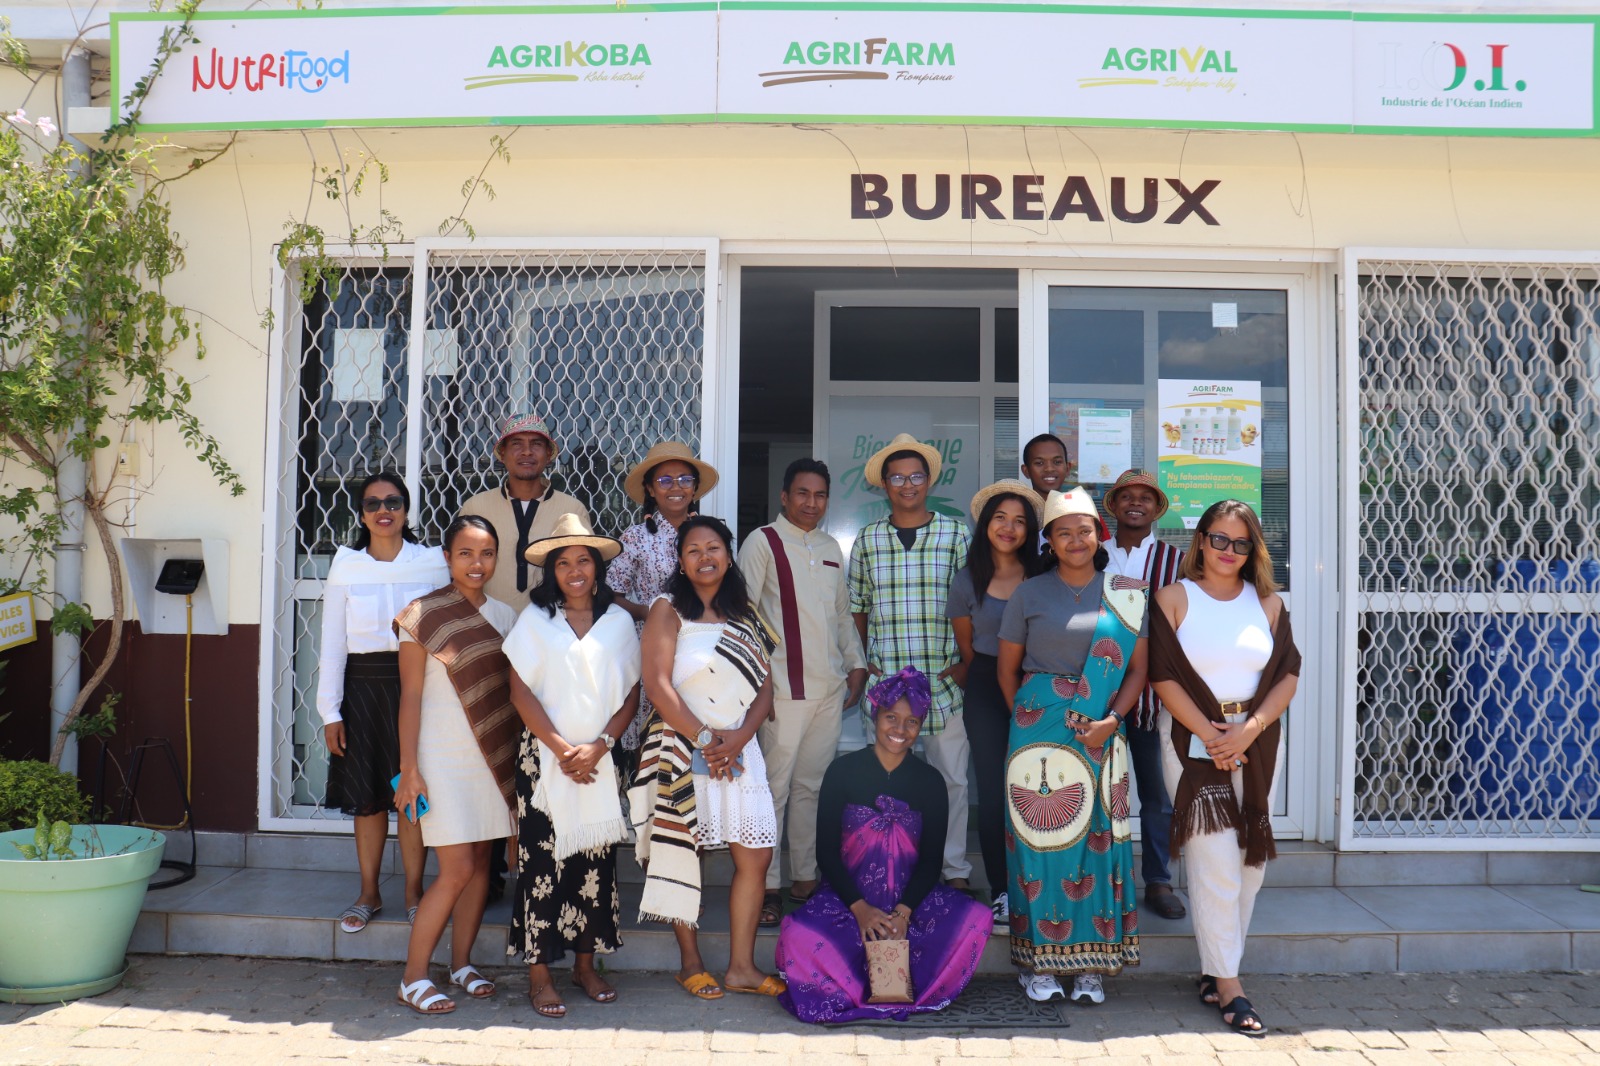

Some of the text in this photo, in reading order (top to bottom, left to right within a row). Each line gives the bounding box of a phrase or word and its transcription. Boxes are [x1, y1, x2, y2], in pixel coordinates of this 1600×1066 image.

[487, 41, 651, 67] AGRIKOBA
[782, 37, 956, 66] AGRIFARM
[1101, 45, 1238, 73] AGRIVAL
[895, 70, 954, 85] Fiompiana
[1381, 96, 1428, 108] Industrie
[1431, 97, 1443, 107] de
[1489, 98, 1523, 109] Indien
[850, 173, 1222, 226] BUREAUX
[1192, 384, 1234, 393] AGRIFARM
[1167, 473, 1178, 482] Ny
